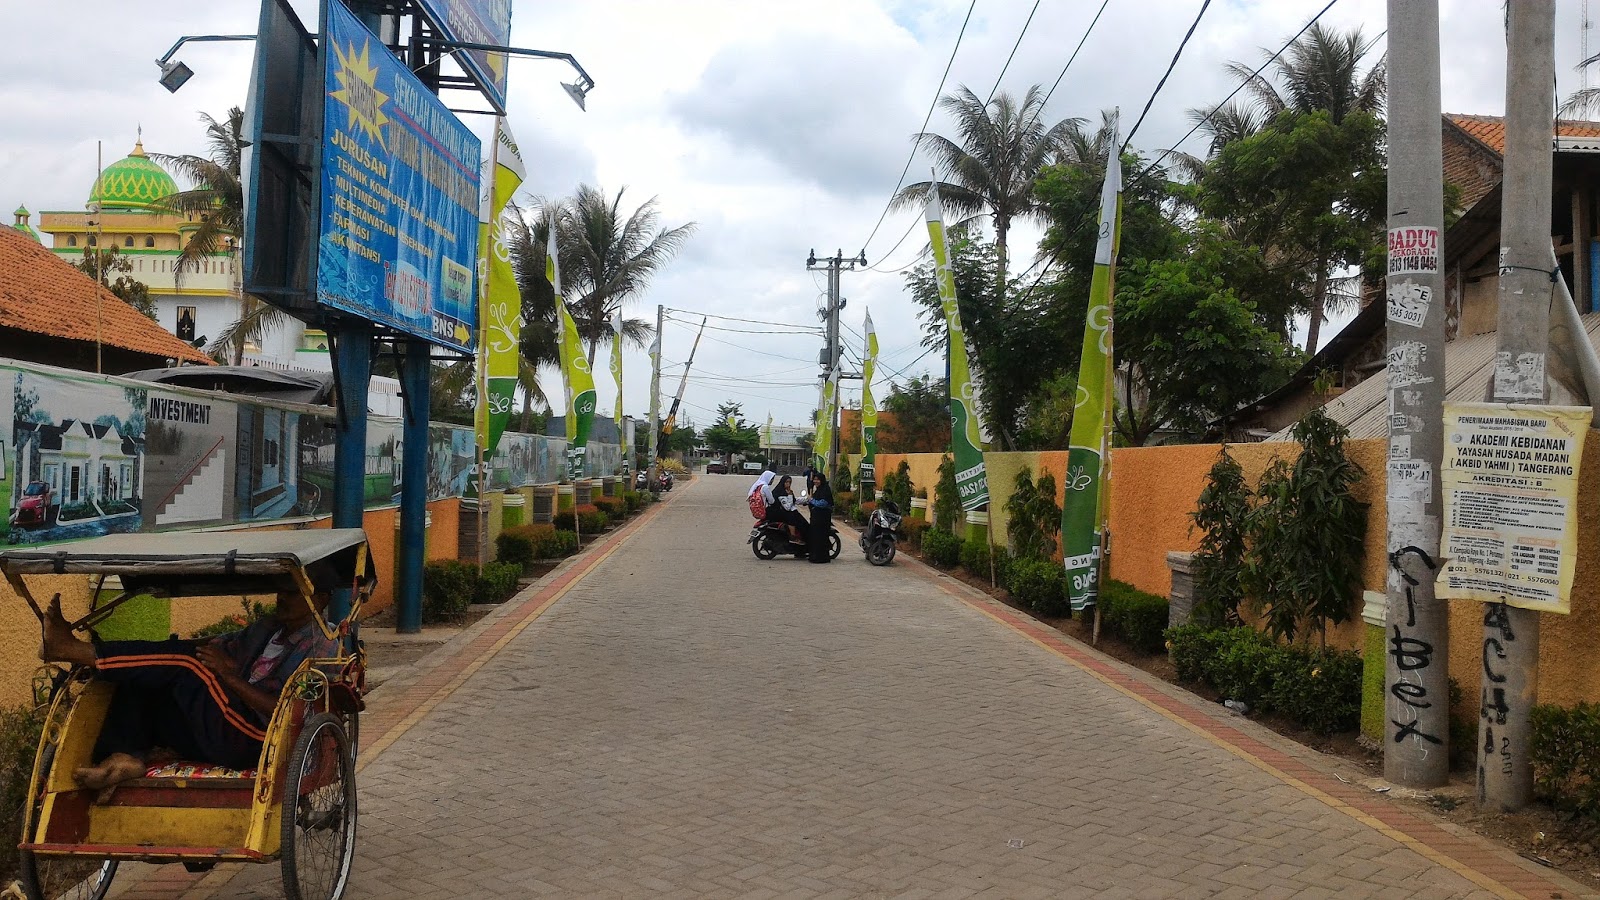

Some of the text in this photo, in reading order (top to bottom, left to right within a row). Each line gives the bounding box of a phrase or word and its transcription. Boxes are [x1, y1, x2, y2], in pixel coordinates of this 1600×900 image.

[394, 70, 429, 131] SEKOLAH
[431, 105, 462, 161] NASIONAL
[330, 125, 386, 180] JURUSAN
[335, 174, 386, 216] MULTIMEDIA
[336, 155, 367, 187] TEKNIK
[369, 177, 409, 214] KOMPUTER
[333, 210, 370, 242] FARMASI
[334, 193, 395, 238] KEPERAWATAN
[330, 228, 380, 265] AKUNTANSI
[1389, 230, 1439, 251] BADUT
[1393, 248, 1430, 258] DEKORASI
[432, 313, 453, 340] BNS
[1404, 310, 1421, 322] 3031
[149, 397, 212, 425] INVESTMENT
[1458, 417, 1547, 428] PENERIMAAN MAHASISWA BARU
[1470, 434, 1566, 450] AKADEMI KEBIDANAN
[1457, 447, 1570, 463] YAYASAN HUSADA MADANI
[1456, 459, 1482, 468] AKBID
[1484, 460, 1509, 471] YAHMI
[1518, 463, 1573, 476] TANGERANG
[1472, 476, 1528, 486] AKREDITASI
[1508, 573, 1520, 581] 021
[1528, 576, 1559, 586] 55760040
